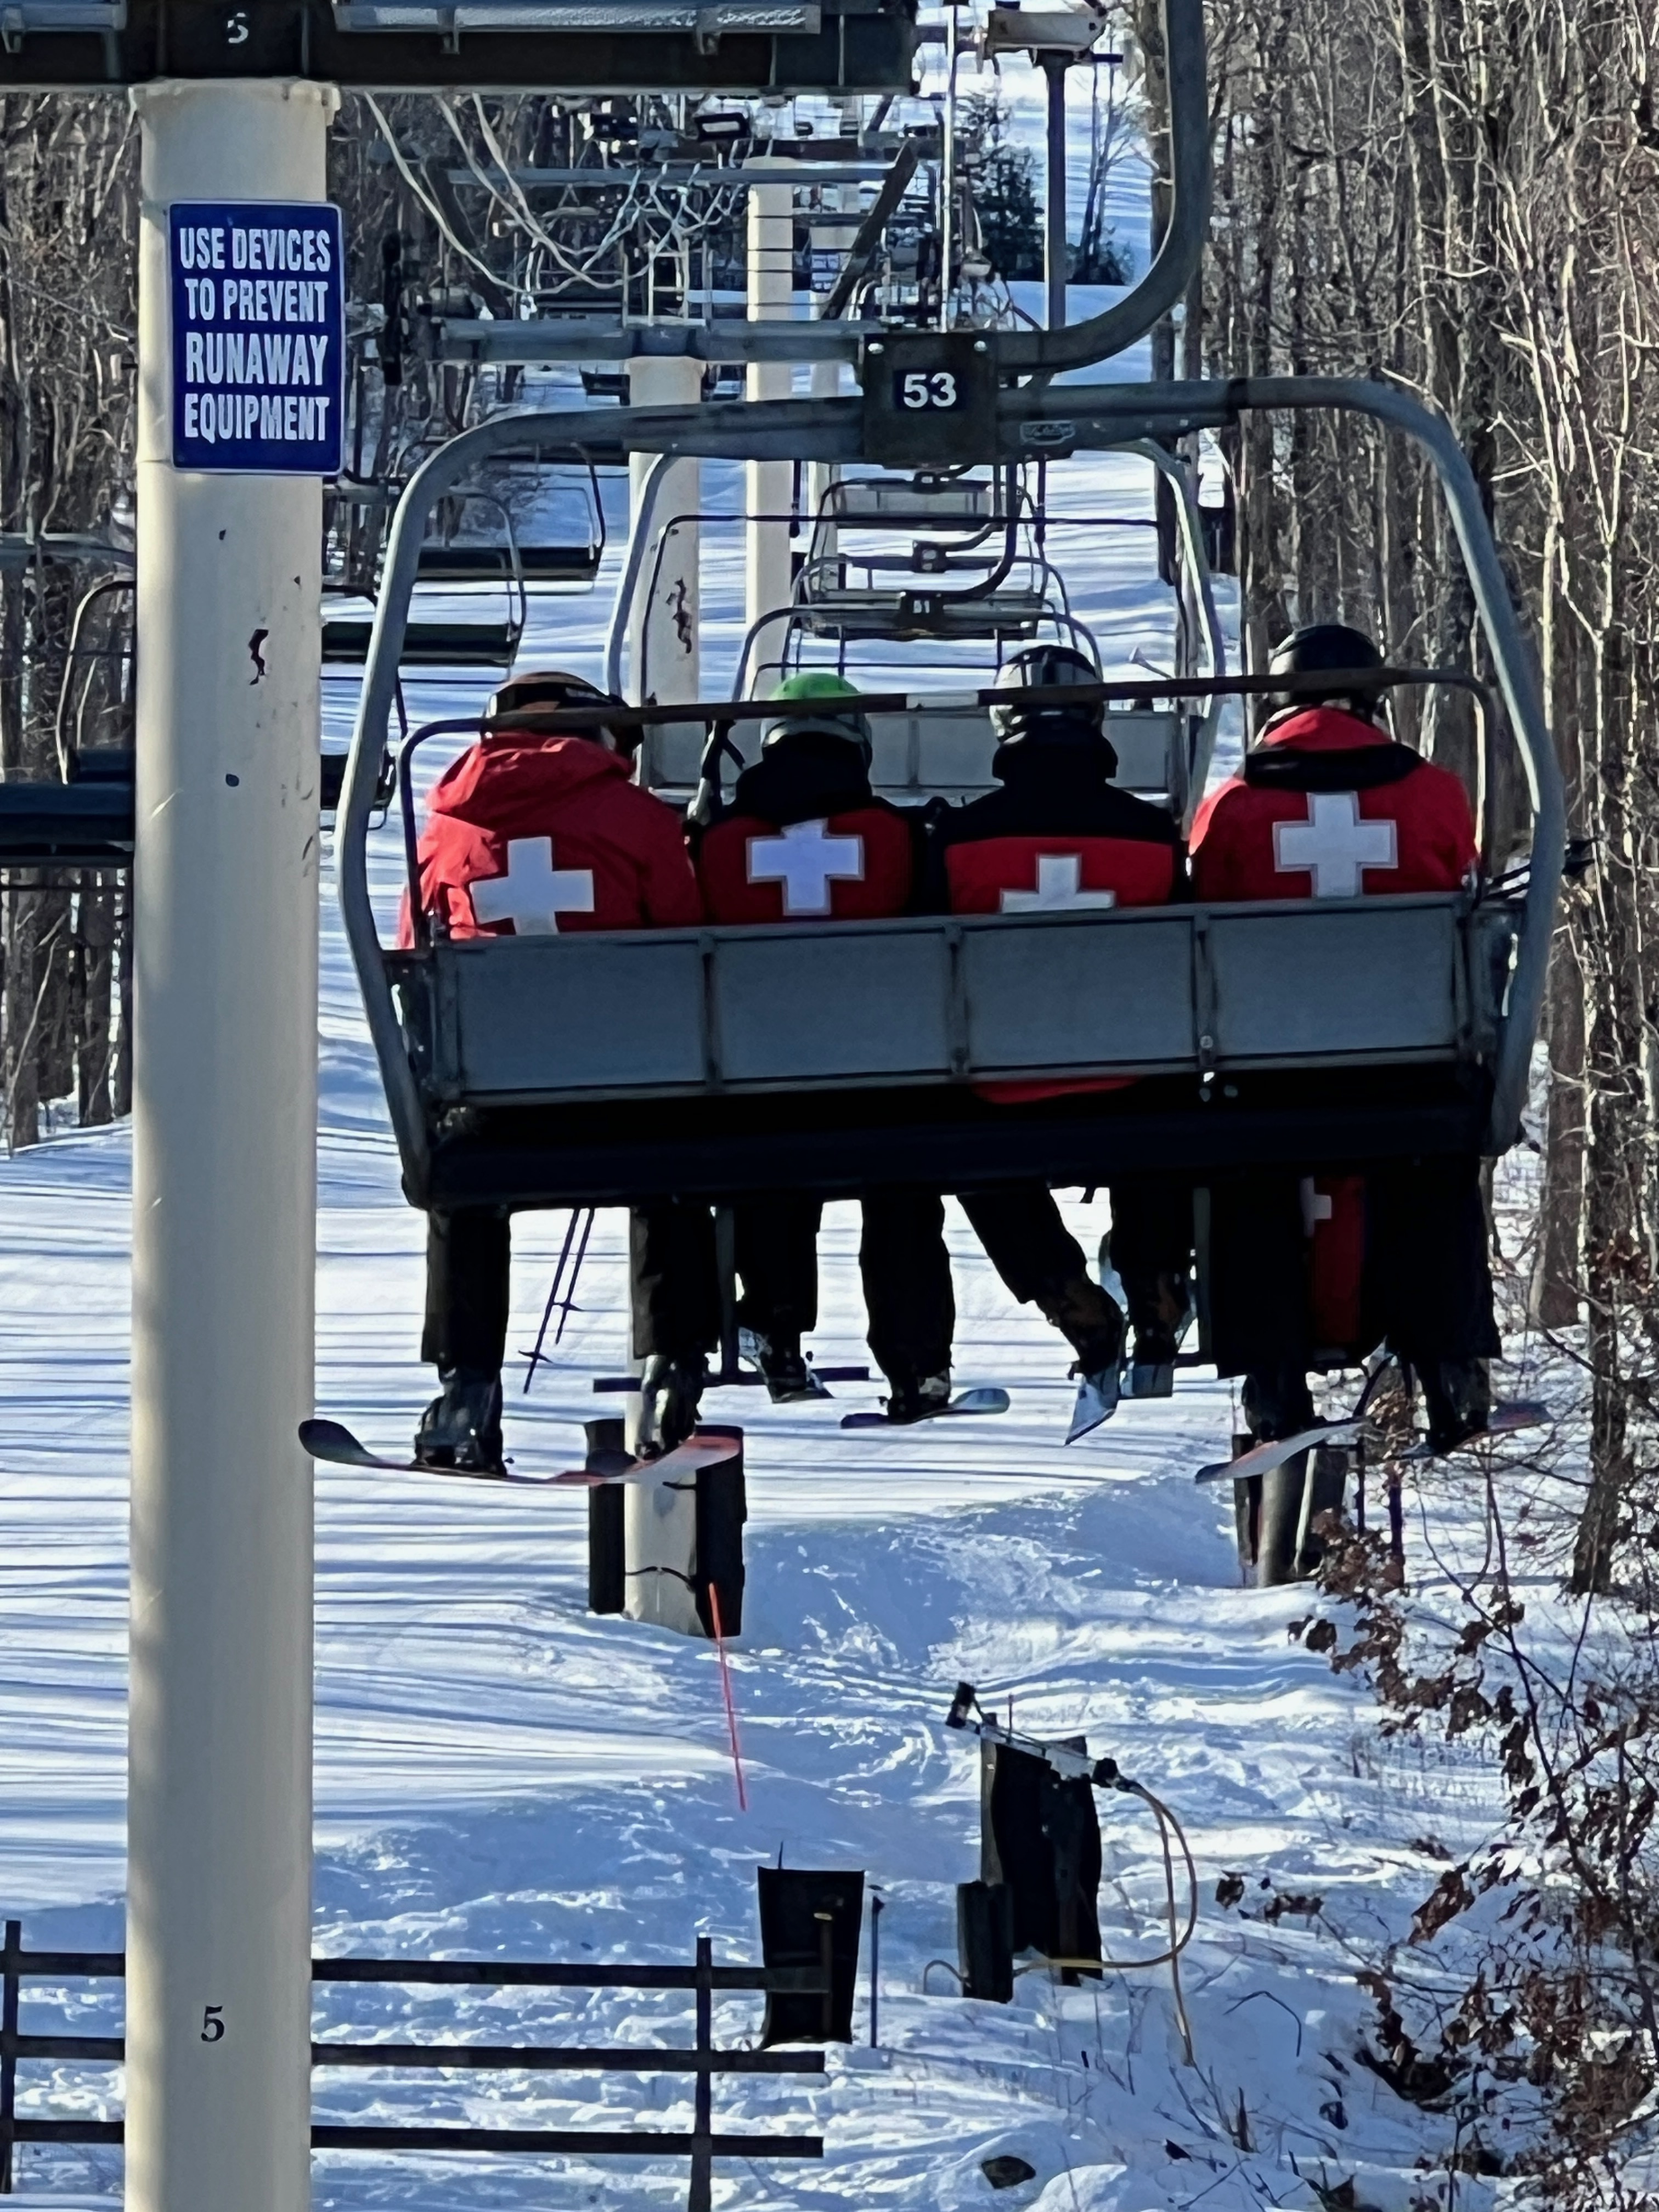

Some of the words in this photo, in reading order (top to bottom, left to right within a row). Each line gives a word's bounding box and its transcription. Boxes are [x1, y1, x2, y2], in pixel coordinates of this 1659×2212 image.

[227, 12, 249, 43] 5
[180, 228, 225, 270] USE
[232, 228, 330, 272] DEVICES
[185, 279, 215, 321] TO
[223, 280, 328, 323] PREVENT
[186, 332, 328, 386] RUNAWAY
[903, 372, 957, 408] 53
[184, 393, 330, 443] EQUIPMENT
[201, 2005, 224, 2042] 5
